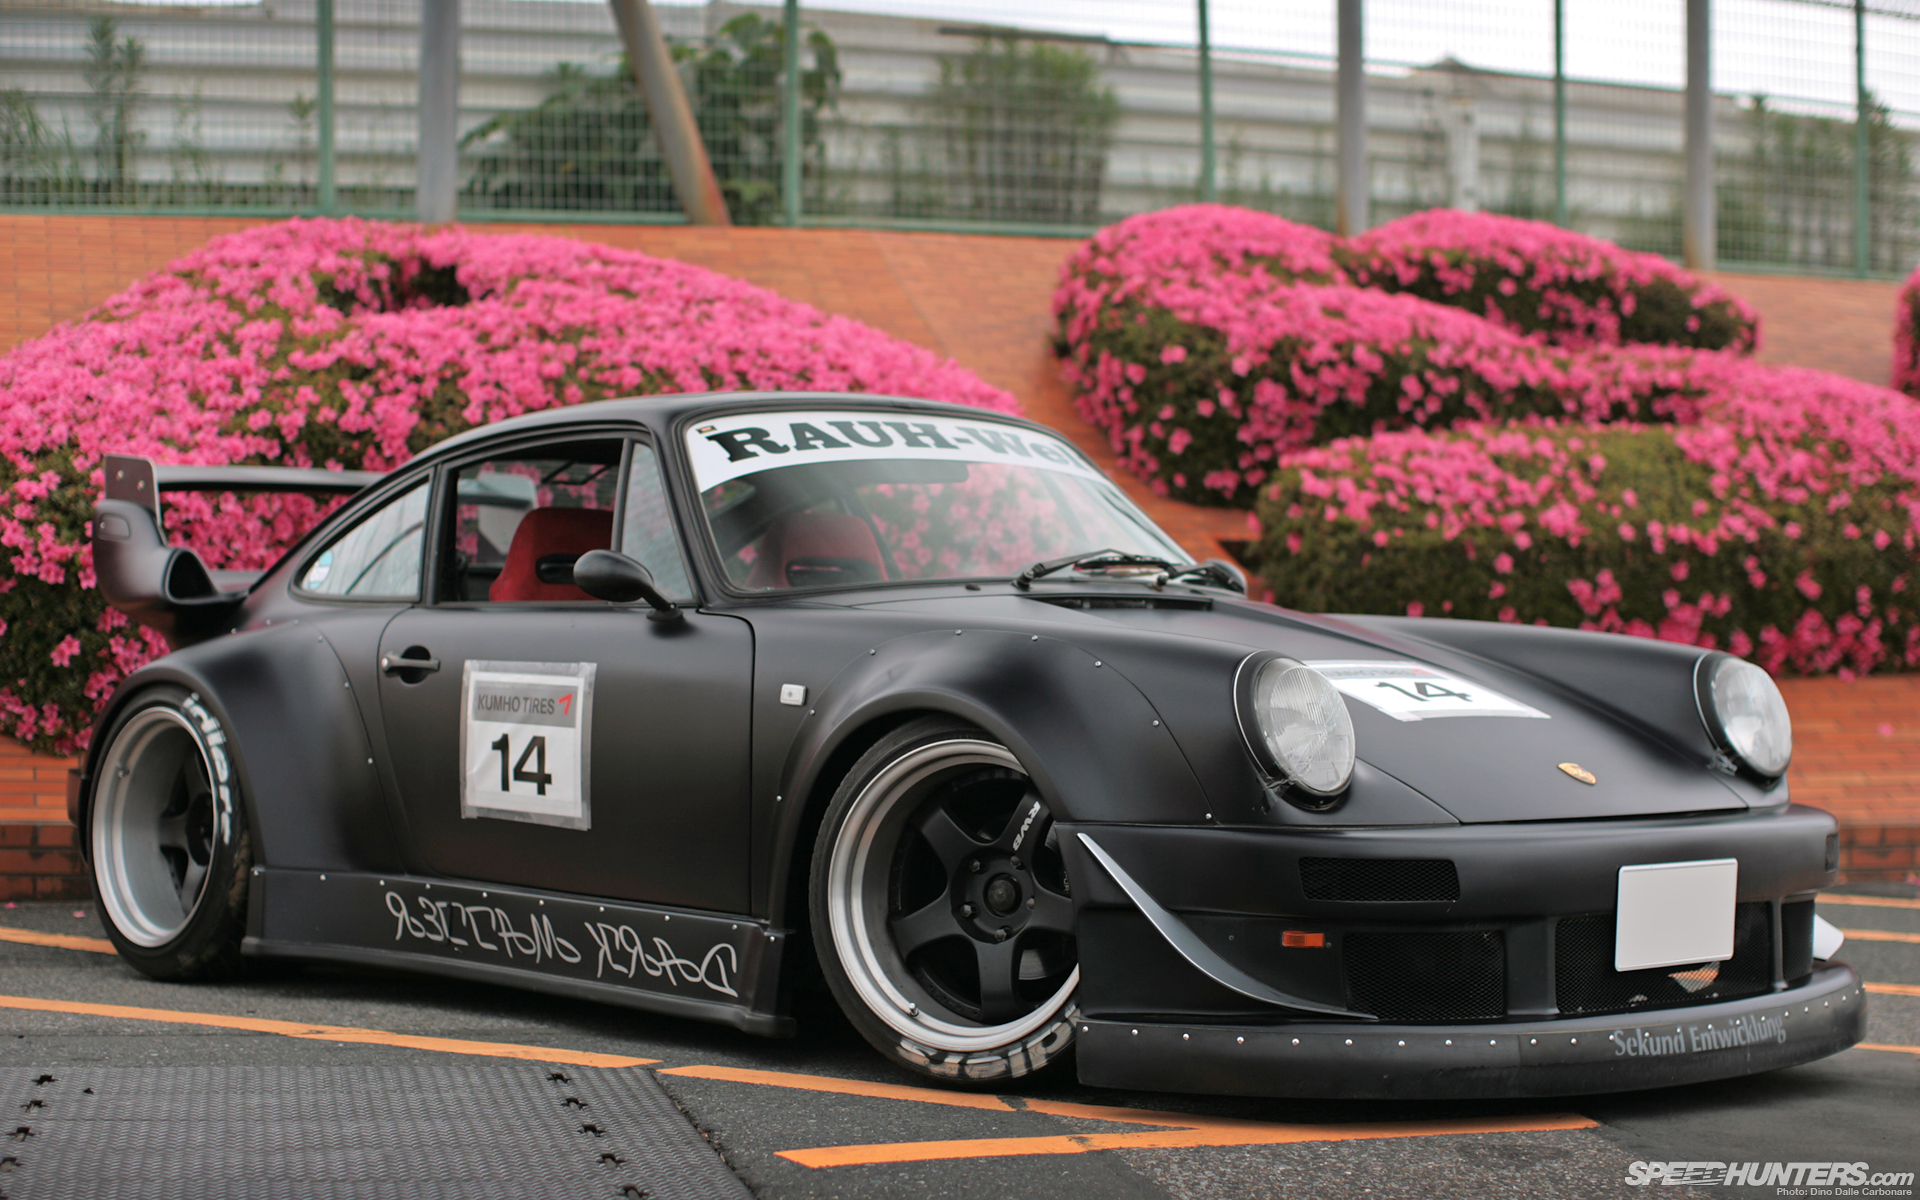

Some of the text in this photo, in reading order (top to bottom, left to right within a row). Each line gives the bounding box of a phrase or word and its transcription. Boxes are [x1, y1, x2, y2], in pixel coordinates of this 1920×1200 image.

[477, 694, 556, 715] KUMHO TIRES
[1374, 682, 1473, 702] 14
[491, 733, 553, 796] 14
[1013, 801, 1041, 851] RWB
[1613, 1014, 1787, 1057] Sekund Entwicklung
